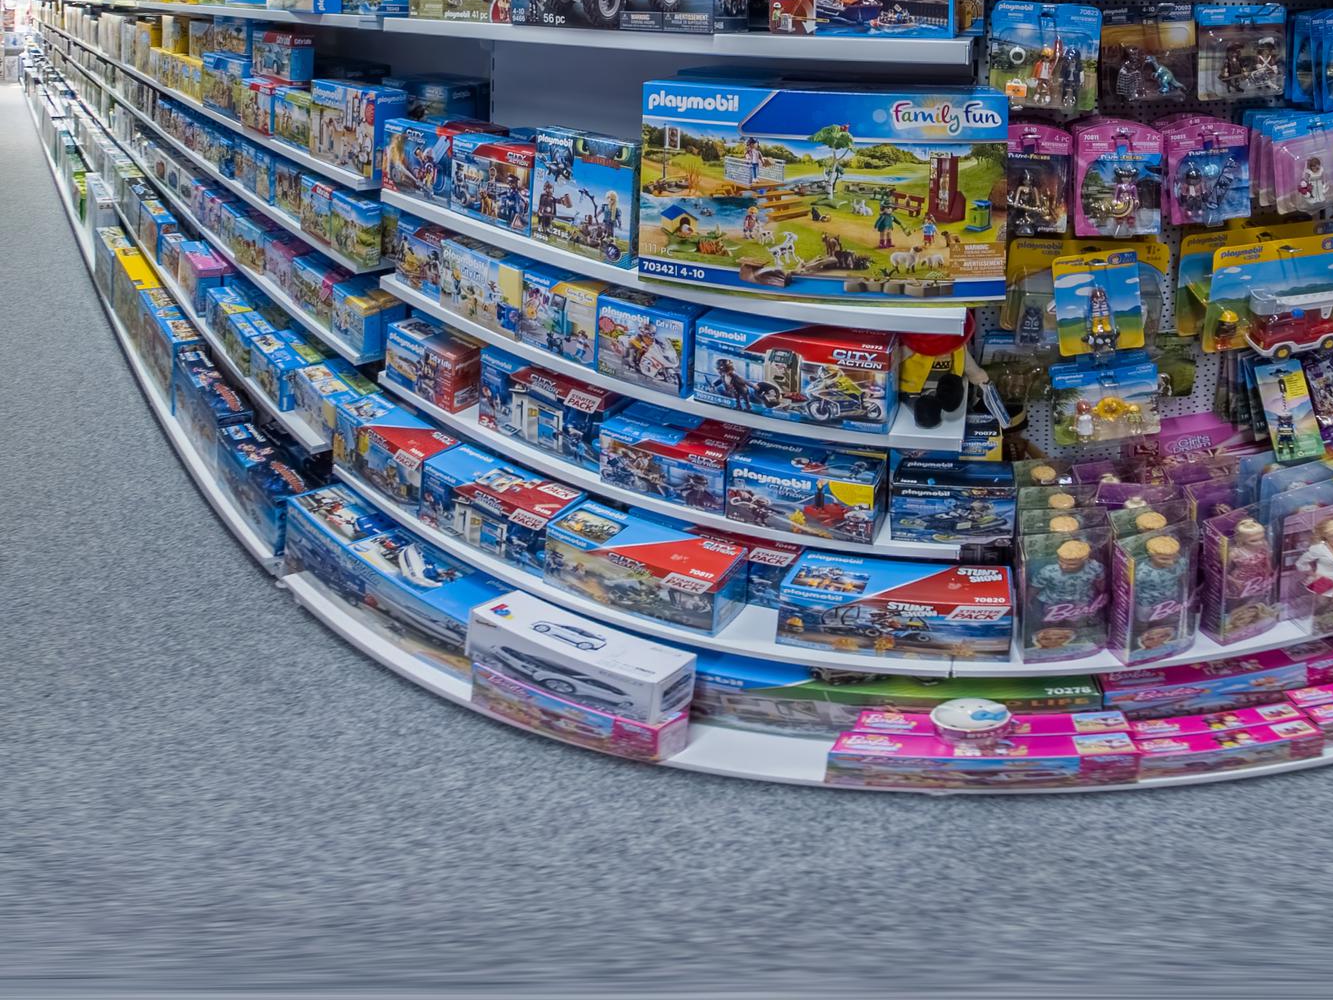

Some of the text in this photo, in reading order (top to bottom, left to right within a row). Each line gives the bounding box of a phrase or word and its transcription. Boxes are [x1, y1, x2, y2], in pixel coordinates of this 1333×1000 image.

[444, 10, 470, 19] playmobil
[543, 13, 566, 25] 56 pc
[649, 92, 739, 113] playmobil
[537, 134, 574, 147] playmobil
[1221, 246, 1264, 259] playmobil
[680, 266, 705, 279] 4-10
[601, 306, 650, 325] playmobil
[698, 326, 747, 342] playmobil
[389, 332, 425, 354] playmobil
[833, 349, 878, 360] CITY
[837, 359, 882, 369] ACTION
[567, 398, 594, 412] PACK
[480, 415, 496, 428] 3+
[749, 438, 803, 453] playmobil
[733, 468, 811, 489] playmobil
[902, 489, 950, 497] playmobil
[584, 503, 628, 520] playmobil
[751, 554, 785, 566] PACK
[807, 553, 863, 564] playmobil
[957, 568, 999, 576] STUNT
[969, 574, 1003, 583] SHOW
[666, 579, 703, 592] PACK
[784, 589, 842, 601] playmobil
[887, 602, 933, 611] STUNT
[900, 609, 938, 618] SHOW
[952, 613, 998, 621] PACK
[1044, 687, 1092, 695] 70278
